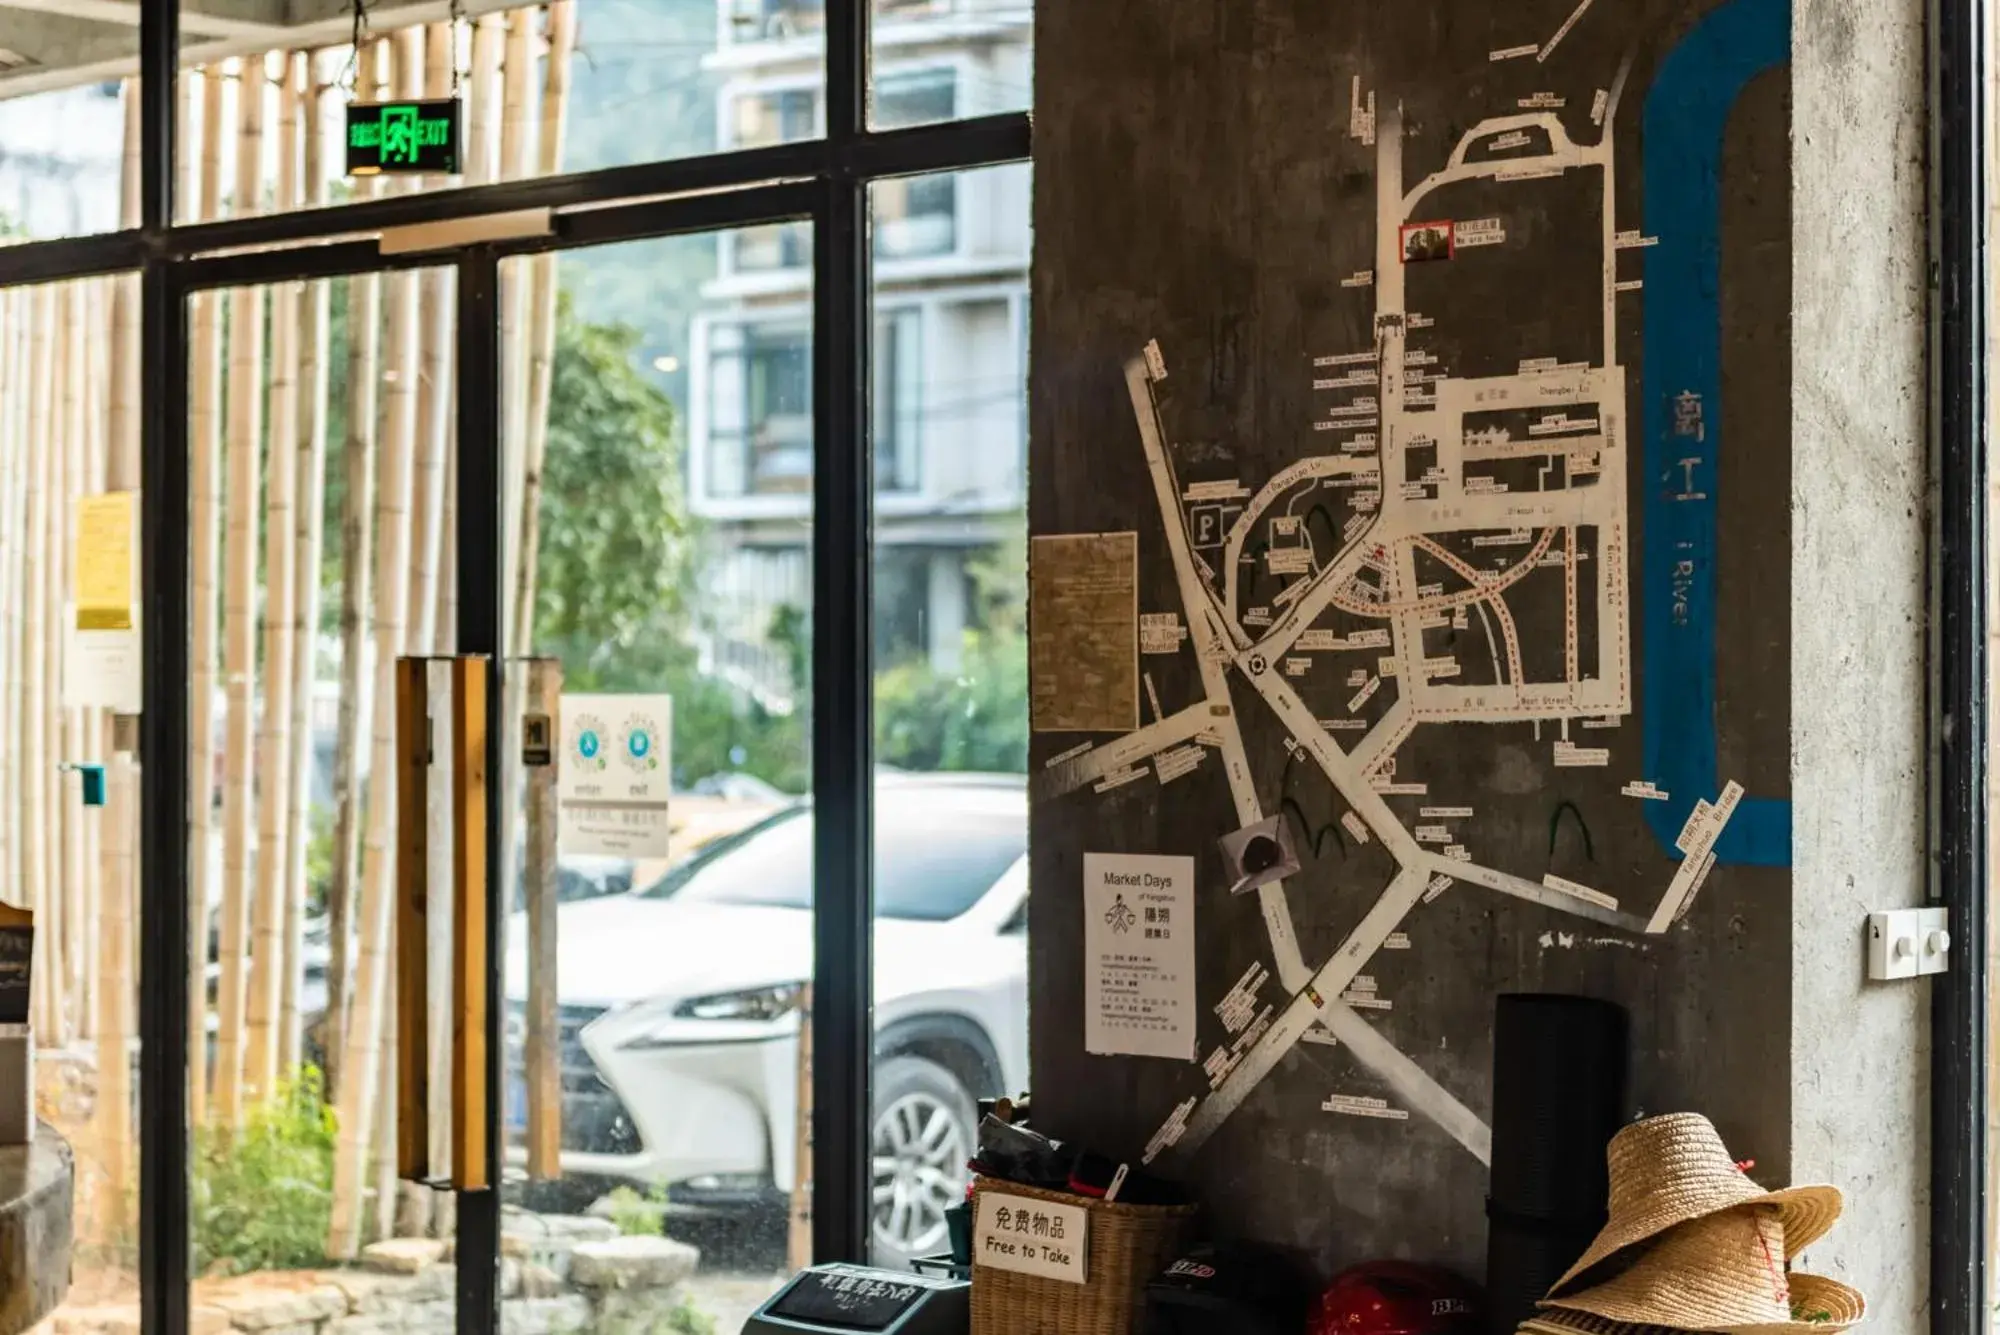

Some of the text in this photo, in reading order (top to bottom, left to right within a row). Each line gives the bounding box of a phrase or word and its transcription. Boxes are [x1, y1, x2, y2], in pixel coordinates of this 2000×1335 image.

[418, 118, 449, 145] EXIT
[1199, 515, 1214, 542] P
[1103, 871, 1173, 891] Market Days
[995, 1206, 1065, 1239] 免费物品
[985, 1235, 1071, 1266] Free to Take
